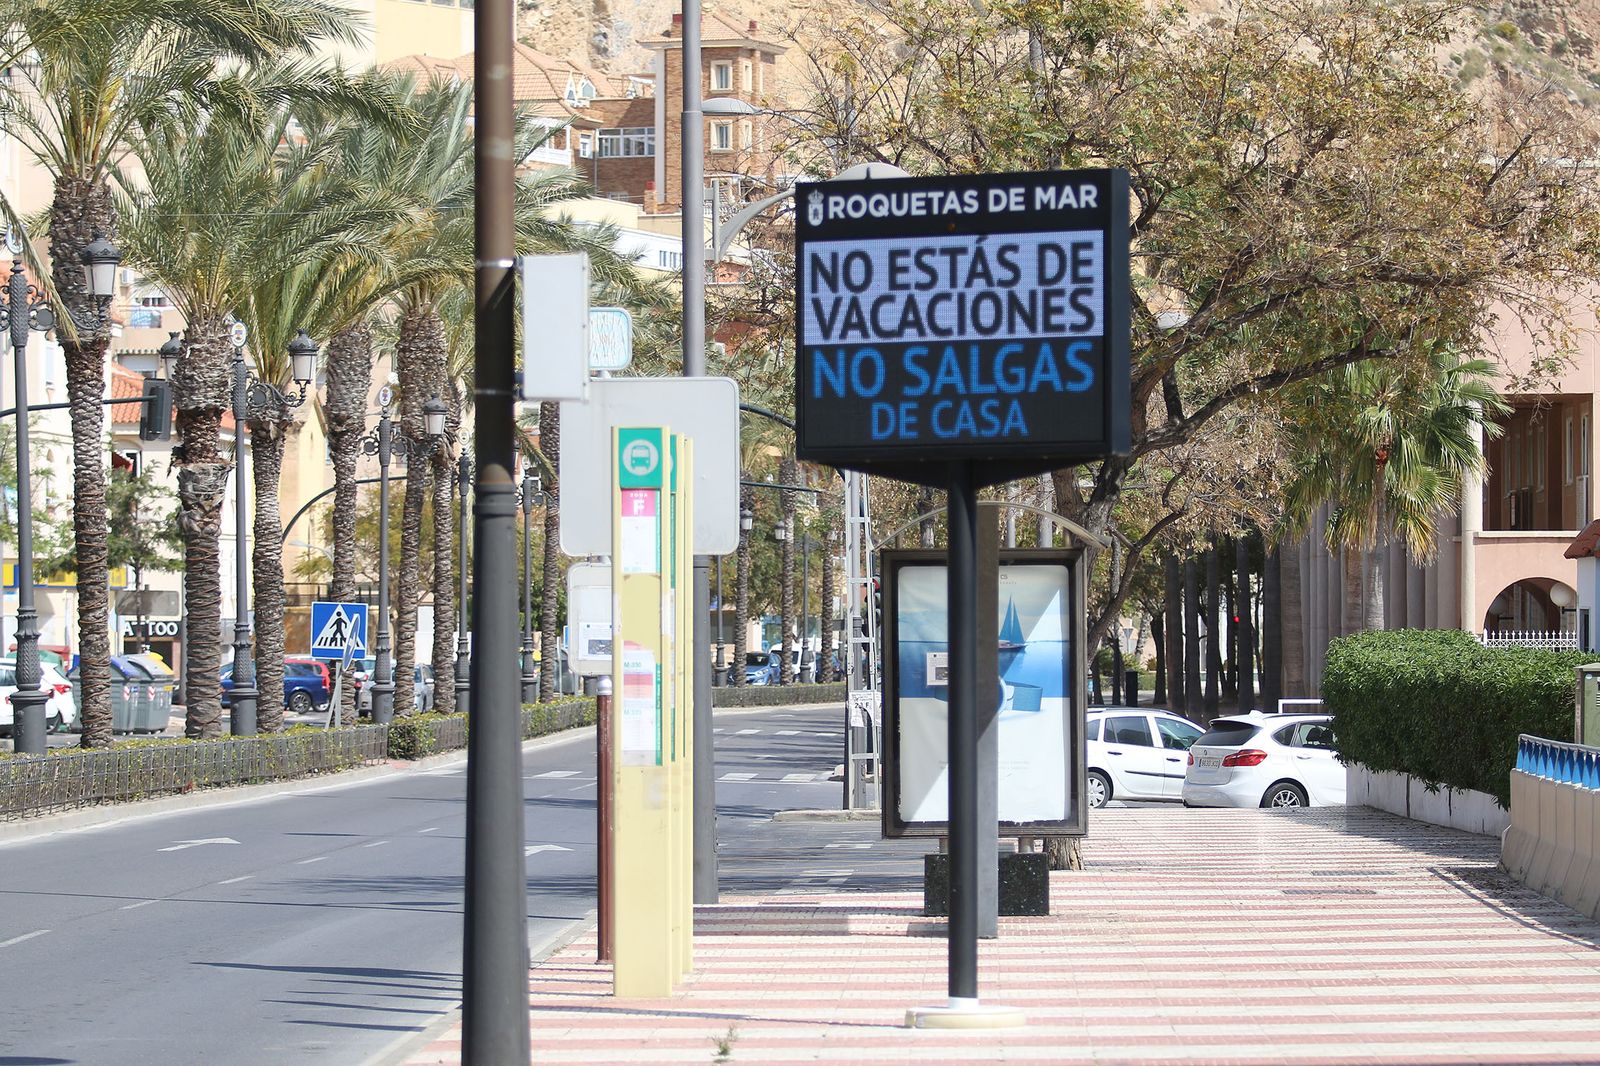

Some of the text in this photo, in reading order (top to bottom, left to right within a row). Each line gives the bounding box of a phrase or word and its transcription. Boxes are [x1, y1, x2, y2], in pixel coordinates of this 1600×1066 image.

[828, 184, 1099, 219] ROQUETAS DE MAR
[810, 236, 1094, 294] NO ESTÁS DE
[811, 287, 1095, 340] VACACIONES
[813, 341, 1094, 398] NO SALGAS
[871, 398, 1029, 440] DE CASA
[633, 499, 645, 515] F
[124, 621, 178, 636] ATOO
